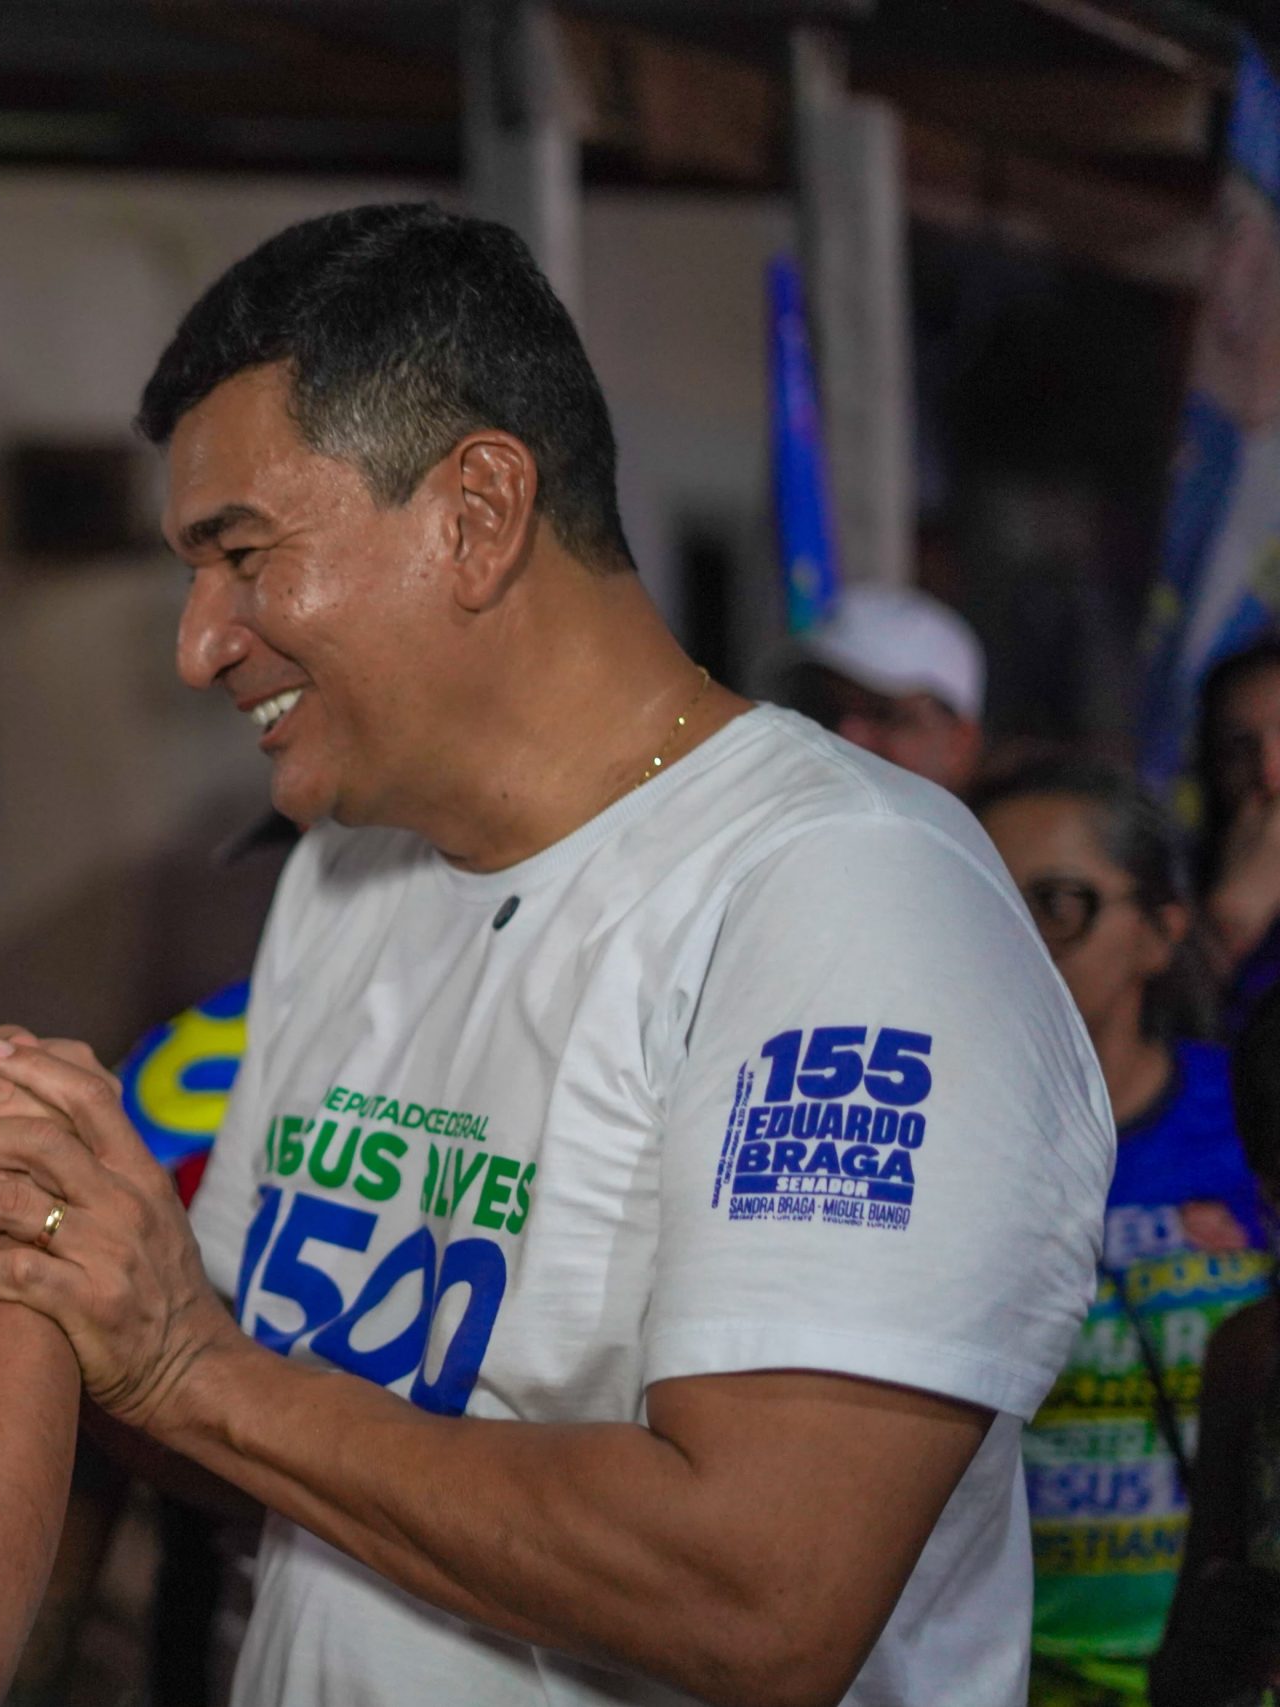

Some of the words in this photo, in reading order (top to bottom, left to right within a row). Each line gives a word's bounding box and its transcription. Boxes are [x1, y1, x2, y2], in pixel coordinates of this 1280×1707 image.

[761, 1026, 932, 1107] 155
[744, 1102, 926, 1150] EDUARDO
[735, 1141, 915, 1184] BRAGA
[729, 1196, 775, 1215] SANDRA
[777, 1196, 816, 1215] BRAGA
[823, 1198, 865, 1220] MIGUEL
[775, 1176, 869, 1198] SENADOR
